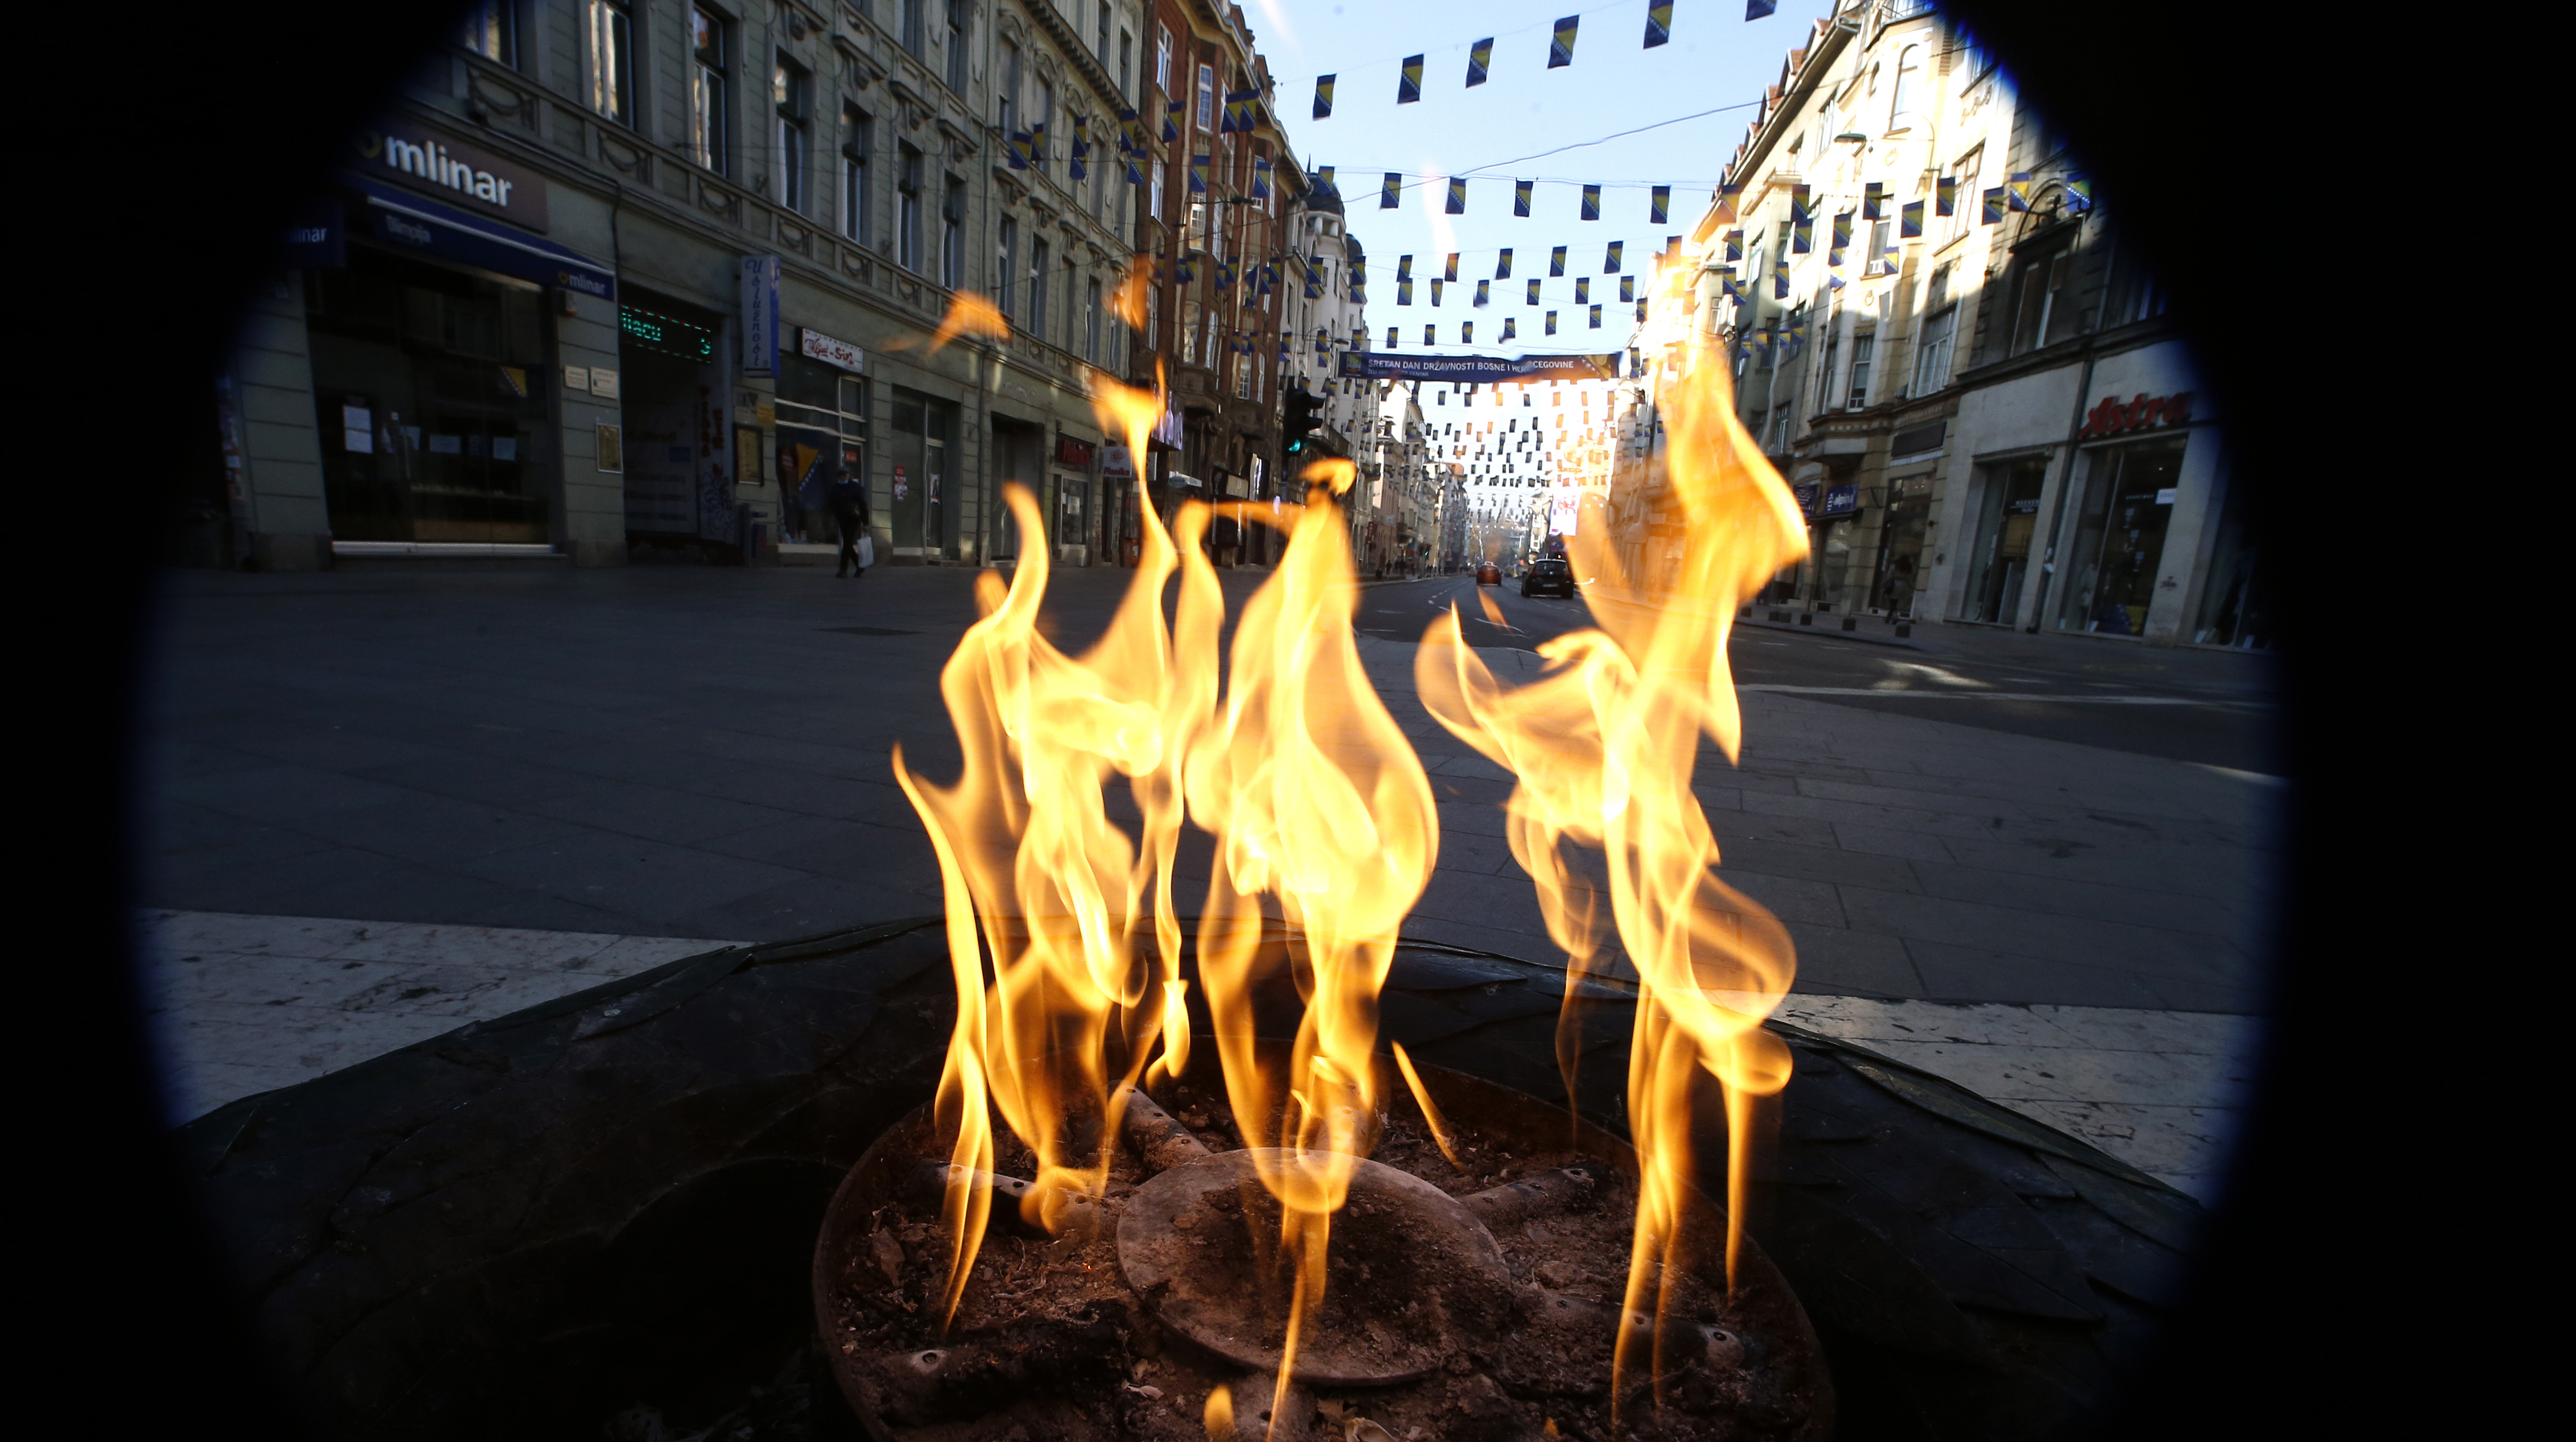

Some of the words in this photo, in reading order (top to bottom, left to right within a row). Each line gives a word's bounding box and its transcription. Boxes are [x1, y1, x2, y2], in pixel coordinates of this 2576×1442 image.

[385, 136, 512, 206] mlinar
[569, 274, 606, 294] mlinar
[1369, 360, 1400, 369] SRETAN
[1403, 361, 1420, 369] DAN
[1423, 360, 1474, 371] DRŽAVNOSTI
[1478, 362, 1504, 371] BOSNE
[2079, 392, 2190, 437] Astra
